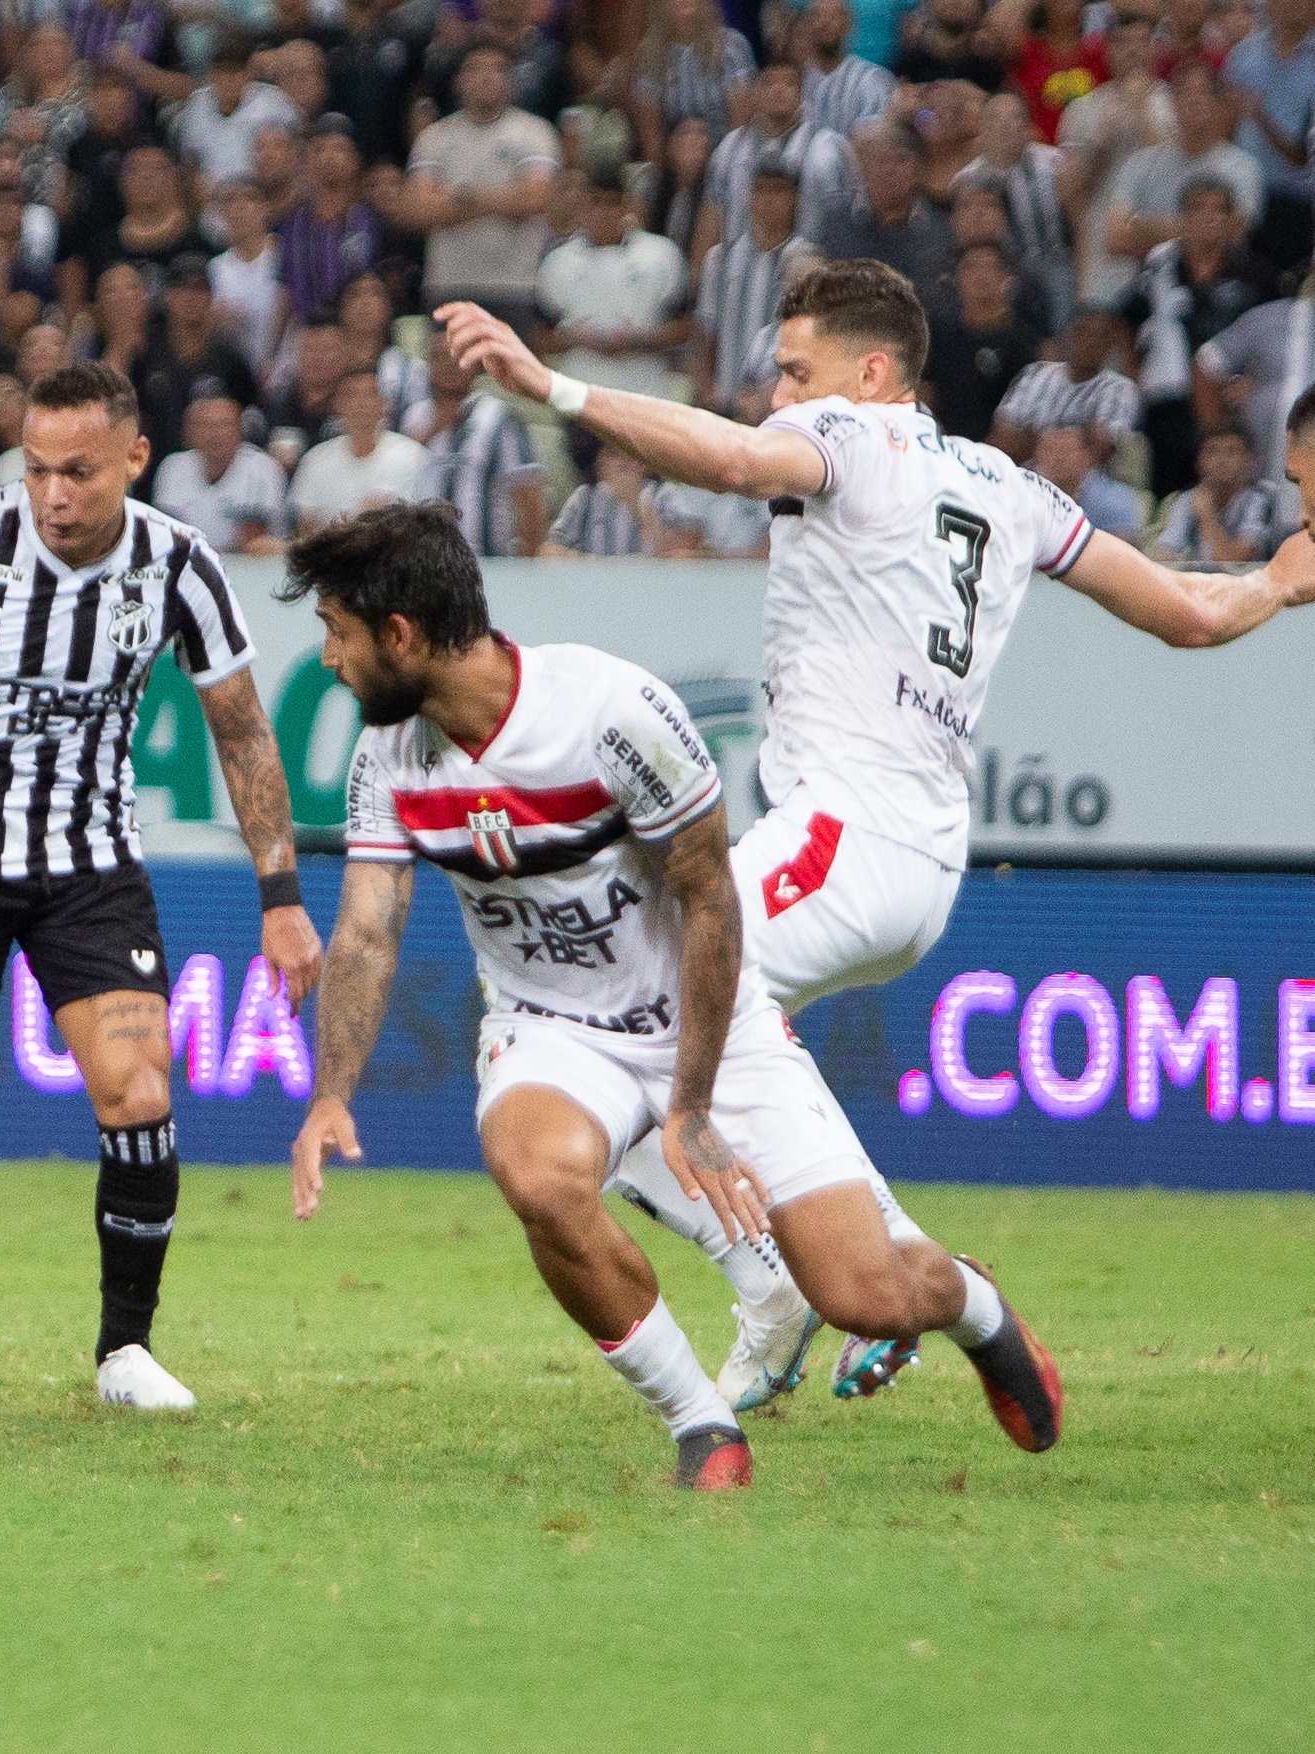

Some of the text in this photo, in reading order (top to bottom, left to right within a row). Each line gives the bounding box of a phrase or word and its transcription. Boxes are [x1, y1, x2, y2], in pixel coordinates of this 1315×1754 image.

[927, 498, 991, 680] 3
[602, 727, 674, 809] SERMED
[540, 928, 617, 969] BET
